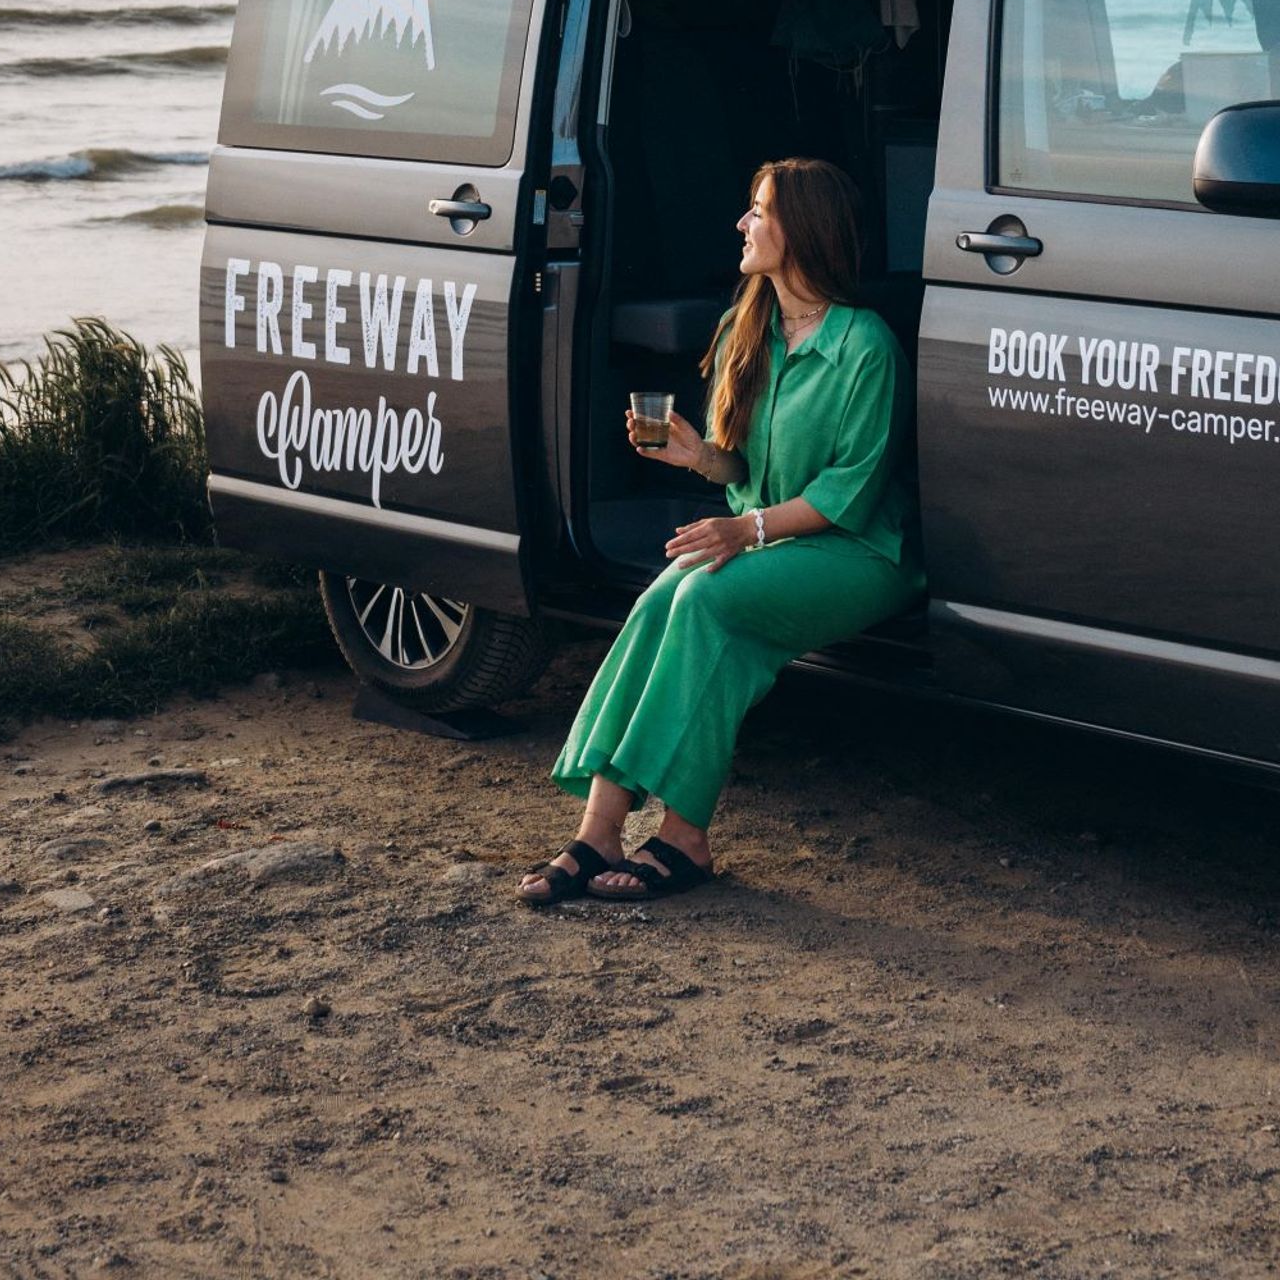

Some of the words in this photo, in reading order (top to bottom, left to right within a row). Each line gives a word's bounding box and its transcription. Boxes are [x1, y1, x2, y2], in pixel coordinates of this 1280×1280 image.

[225, 257, 478, 381] FREEWAY
[987, 327, 1068, 382] BOOK
[1078, 336, 1160, 393] YOUR
[256, 370, 445, 509] Camper
